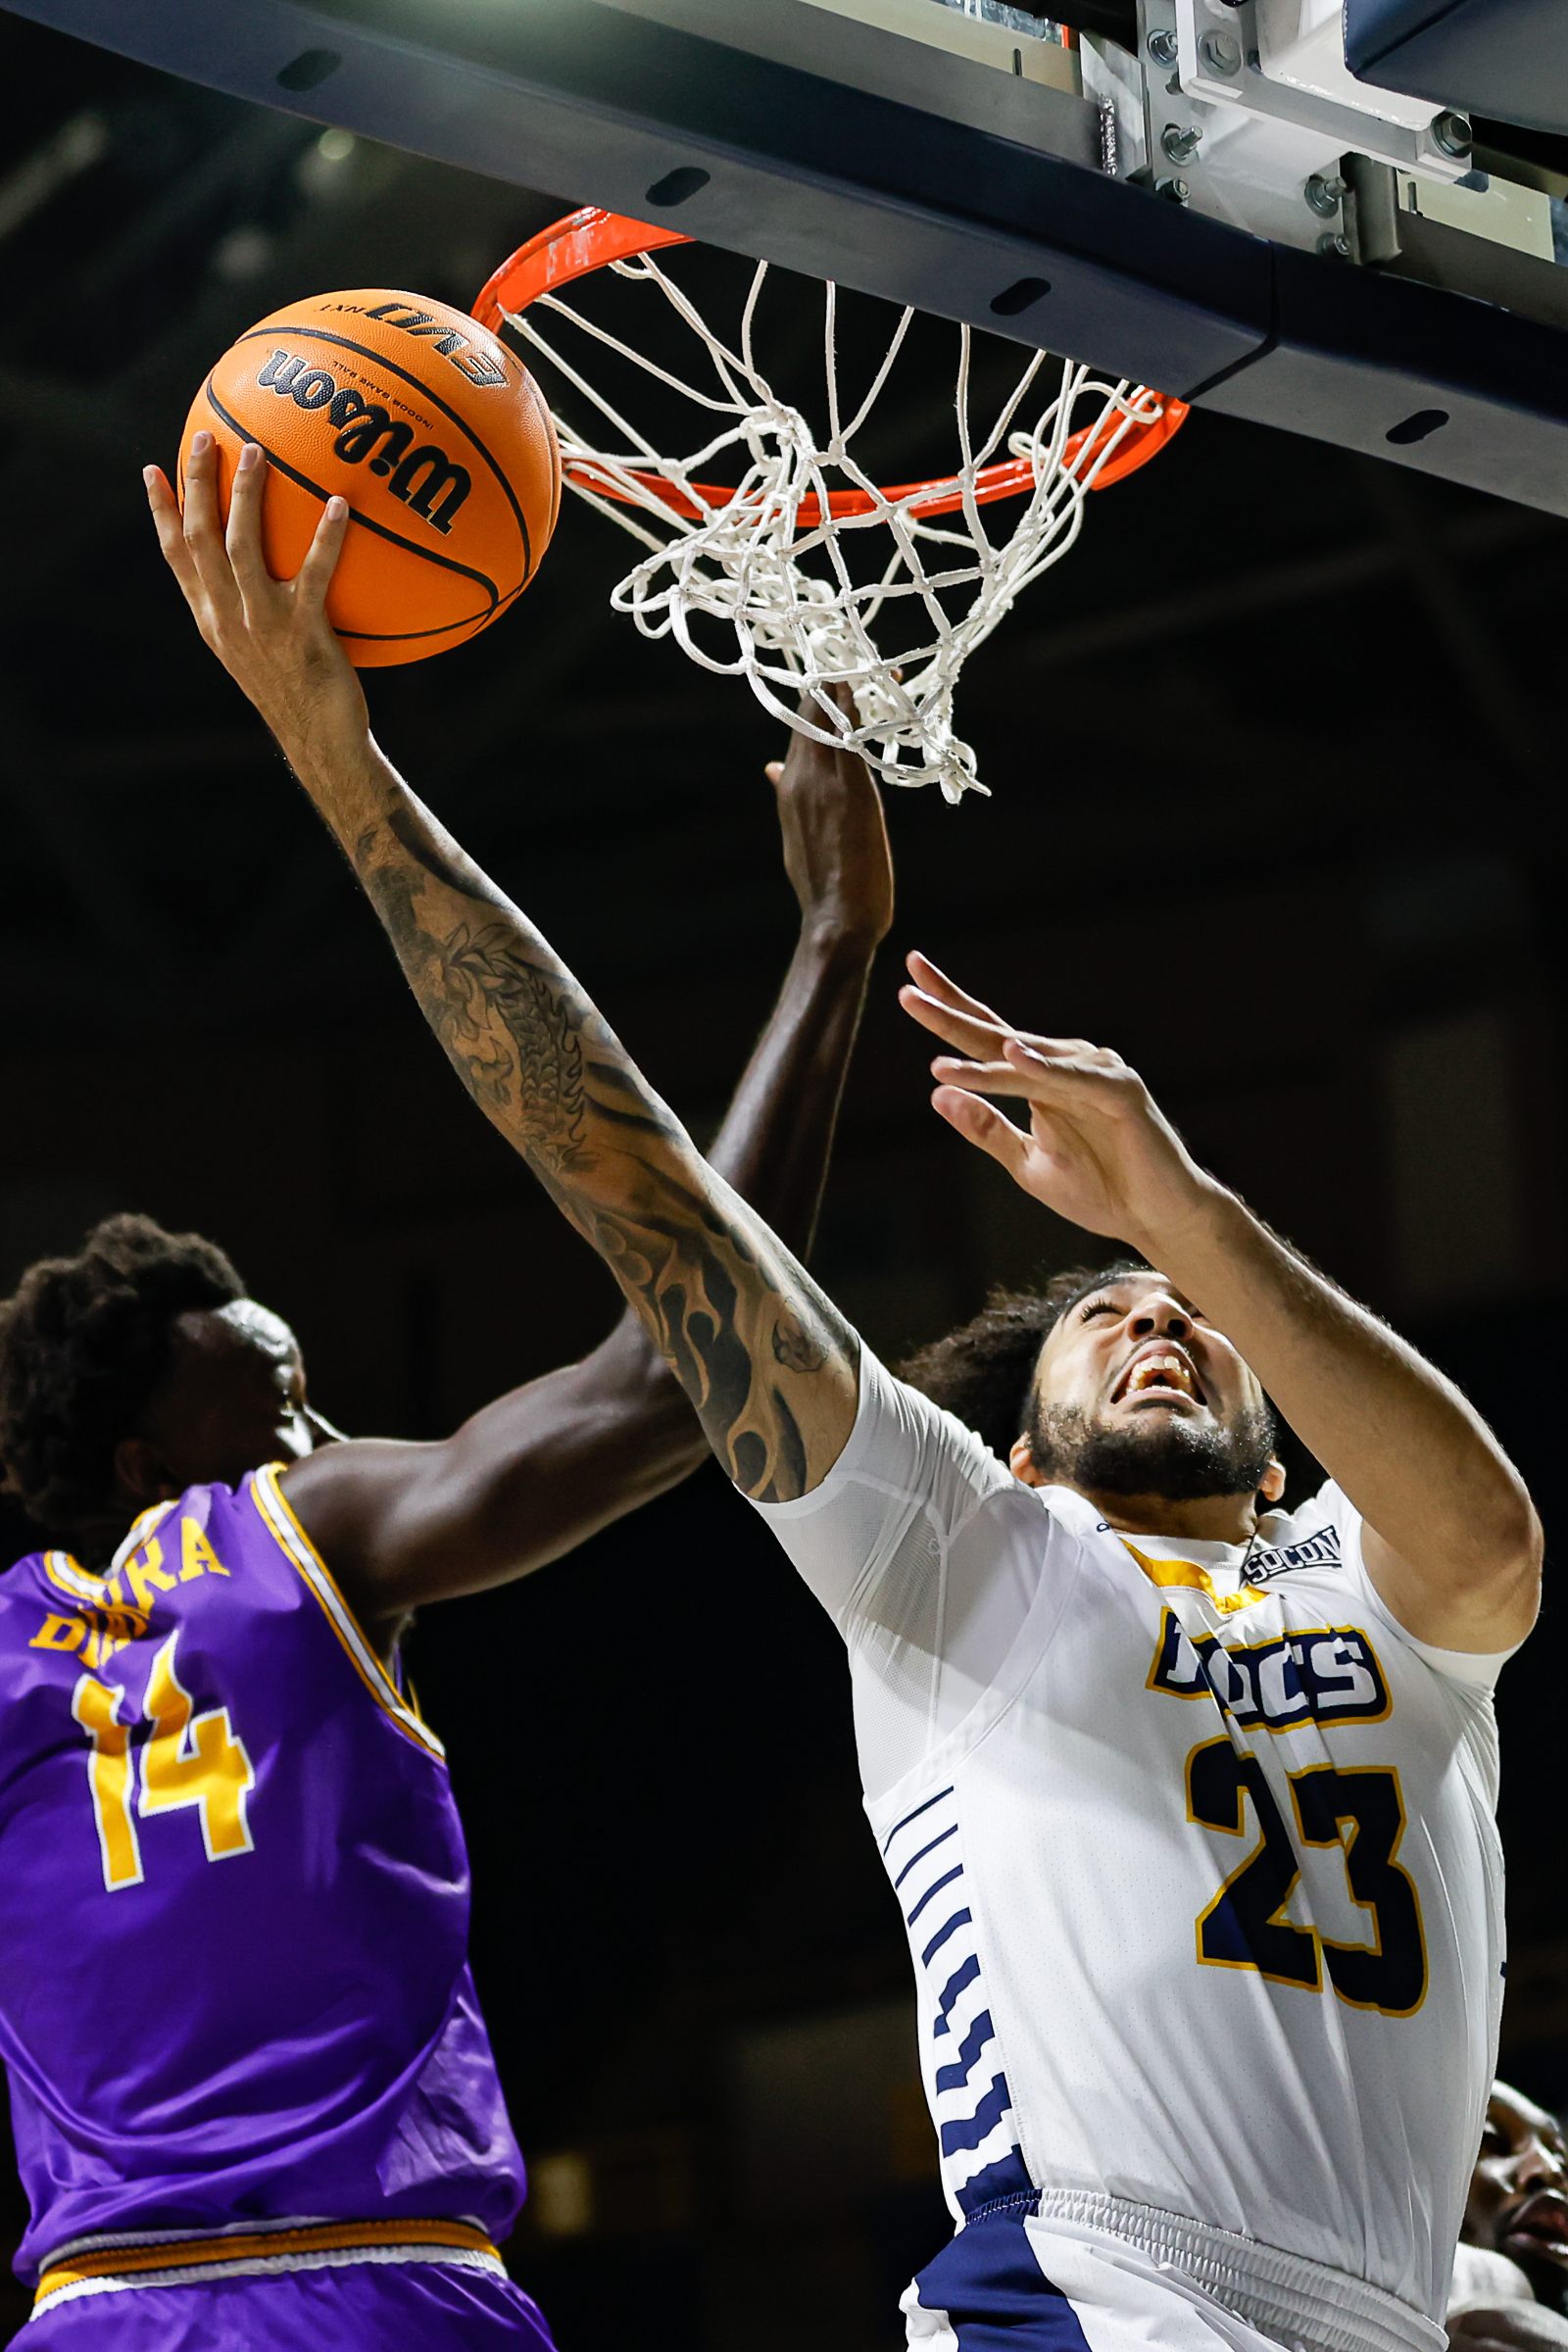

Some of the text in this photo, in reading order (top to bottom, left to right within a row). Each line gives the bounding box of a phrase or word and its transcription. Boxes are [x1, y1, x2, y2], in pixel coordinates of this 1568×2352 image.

[333, 361, 434, 430] INDOOR GAME BALL
[365, 302, 511, 388] EVO
[257, 348, 471, 536] Wilson
[1244, 1528, 1342, 1583] SOCON
[72, 1630, 255, 1892] 14
[1185, 1734, 1428, 2018] 23
